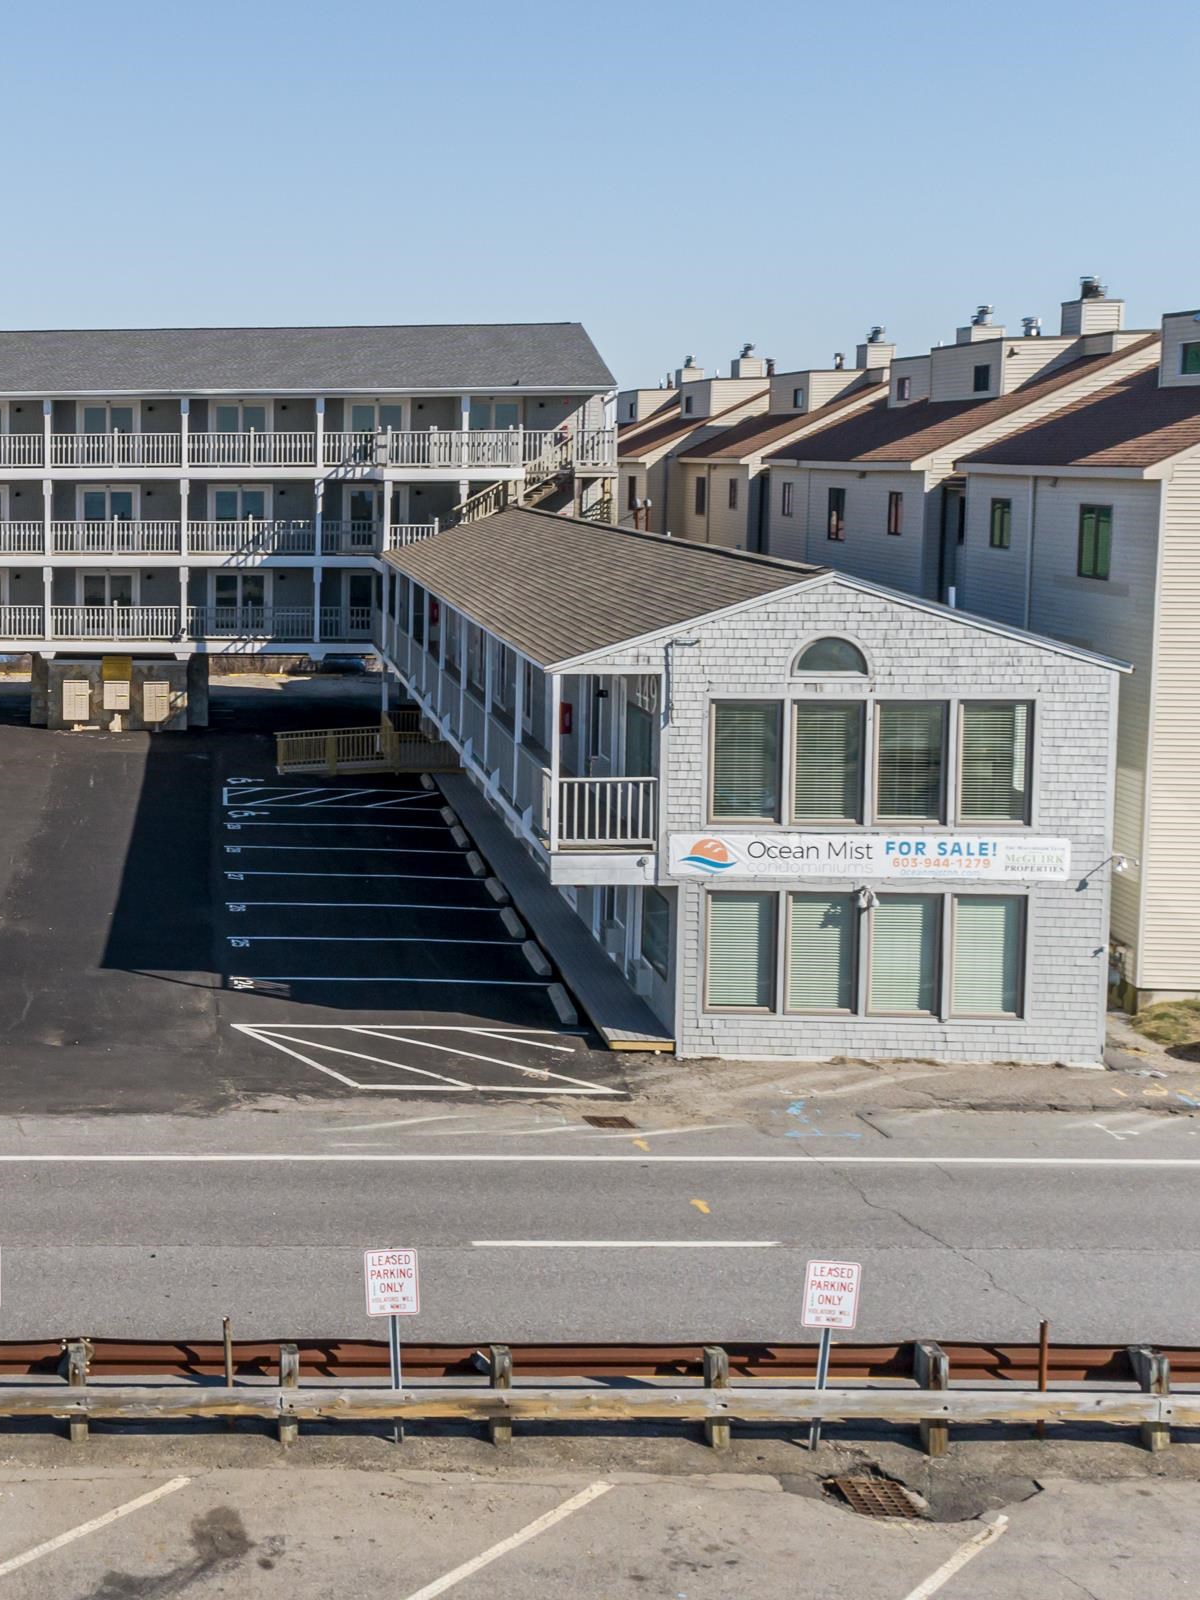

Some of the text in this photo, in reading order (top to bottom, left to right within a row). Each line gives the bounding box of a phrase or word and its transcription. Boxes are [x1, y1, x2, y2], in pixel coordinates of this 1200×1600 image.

[636, 674, 657, 714] 449
[747, 841, 873, 860] Ocean Mist
[885, 841, 998, 857] FOR SALE!
[747, 861, 874, 874] condominiums
[892, 857, 991, 869] 603-944-1279
[1004, 864, 1065, 873] PROPERTIES
[371, 1254, 411, 1266] LEASED
[370, 1268, 413, 1279] PARKING
[814, 1266, 854, 1279] LEASED
[379, 1282, 404, 1293] ONLY
[810, 1280, 854, 1293] PARKING
[818, 1294, 843, 1306] ONLY
